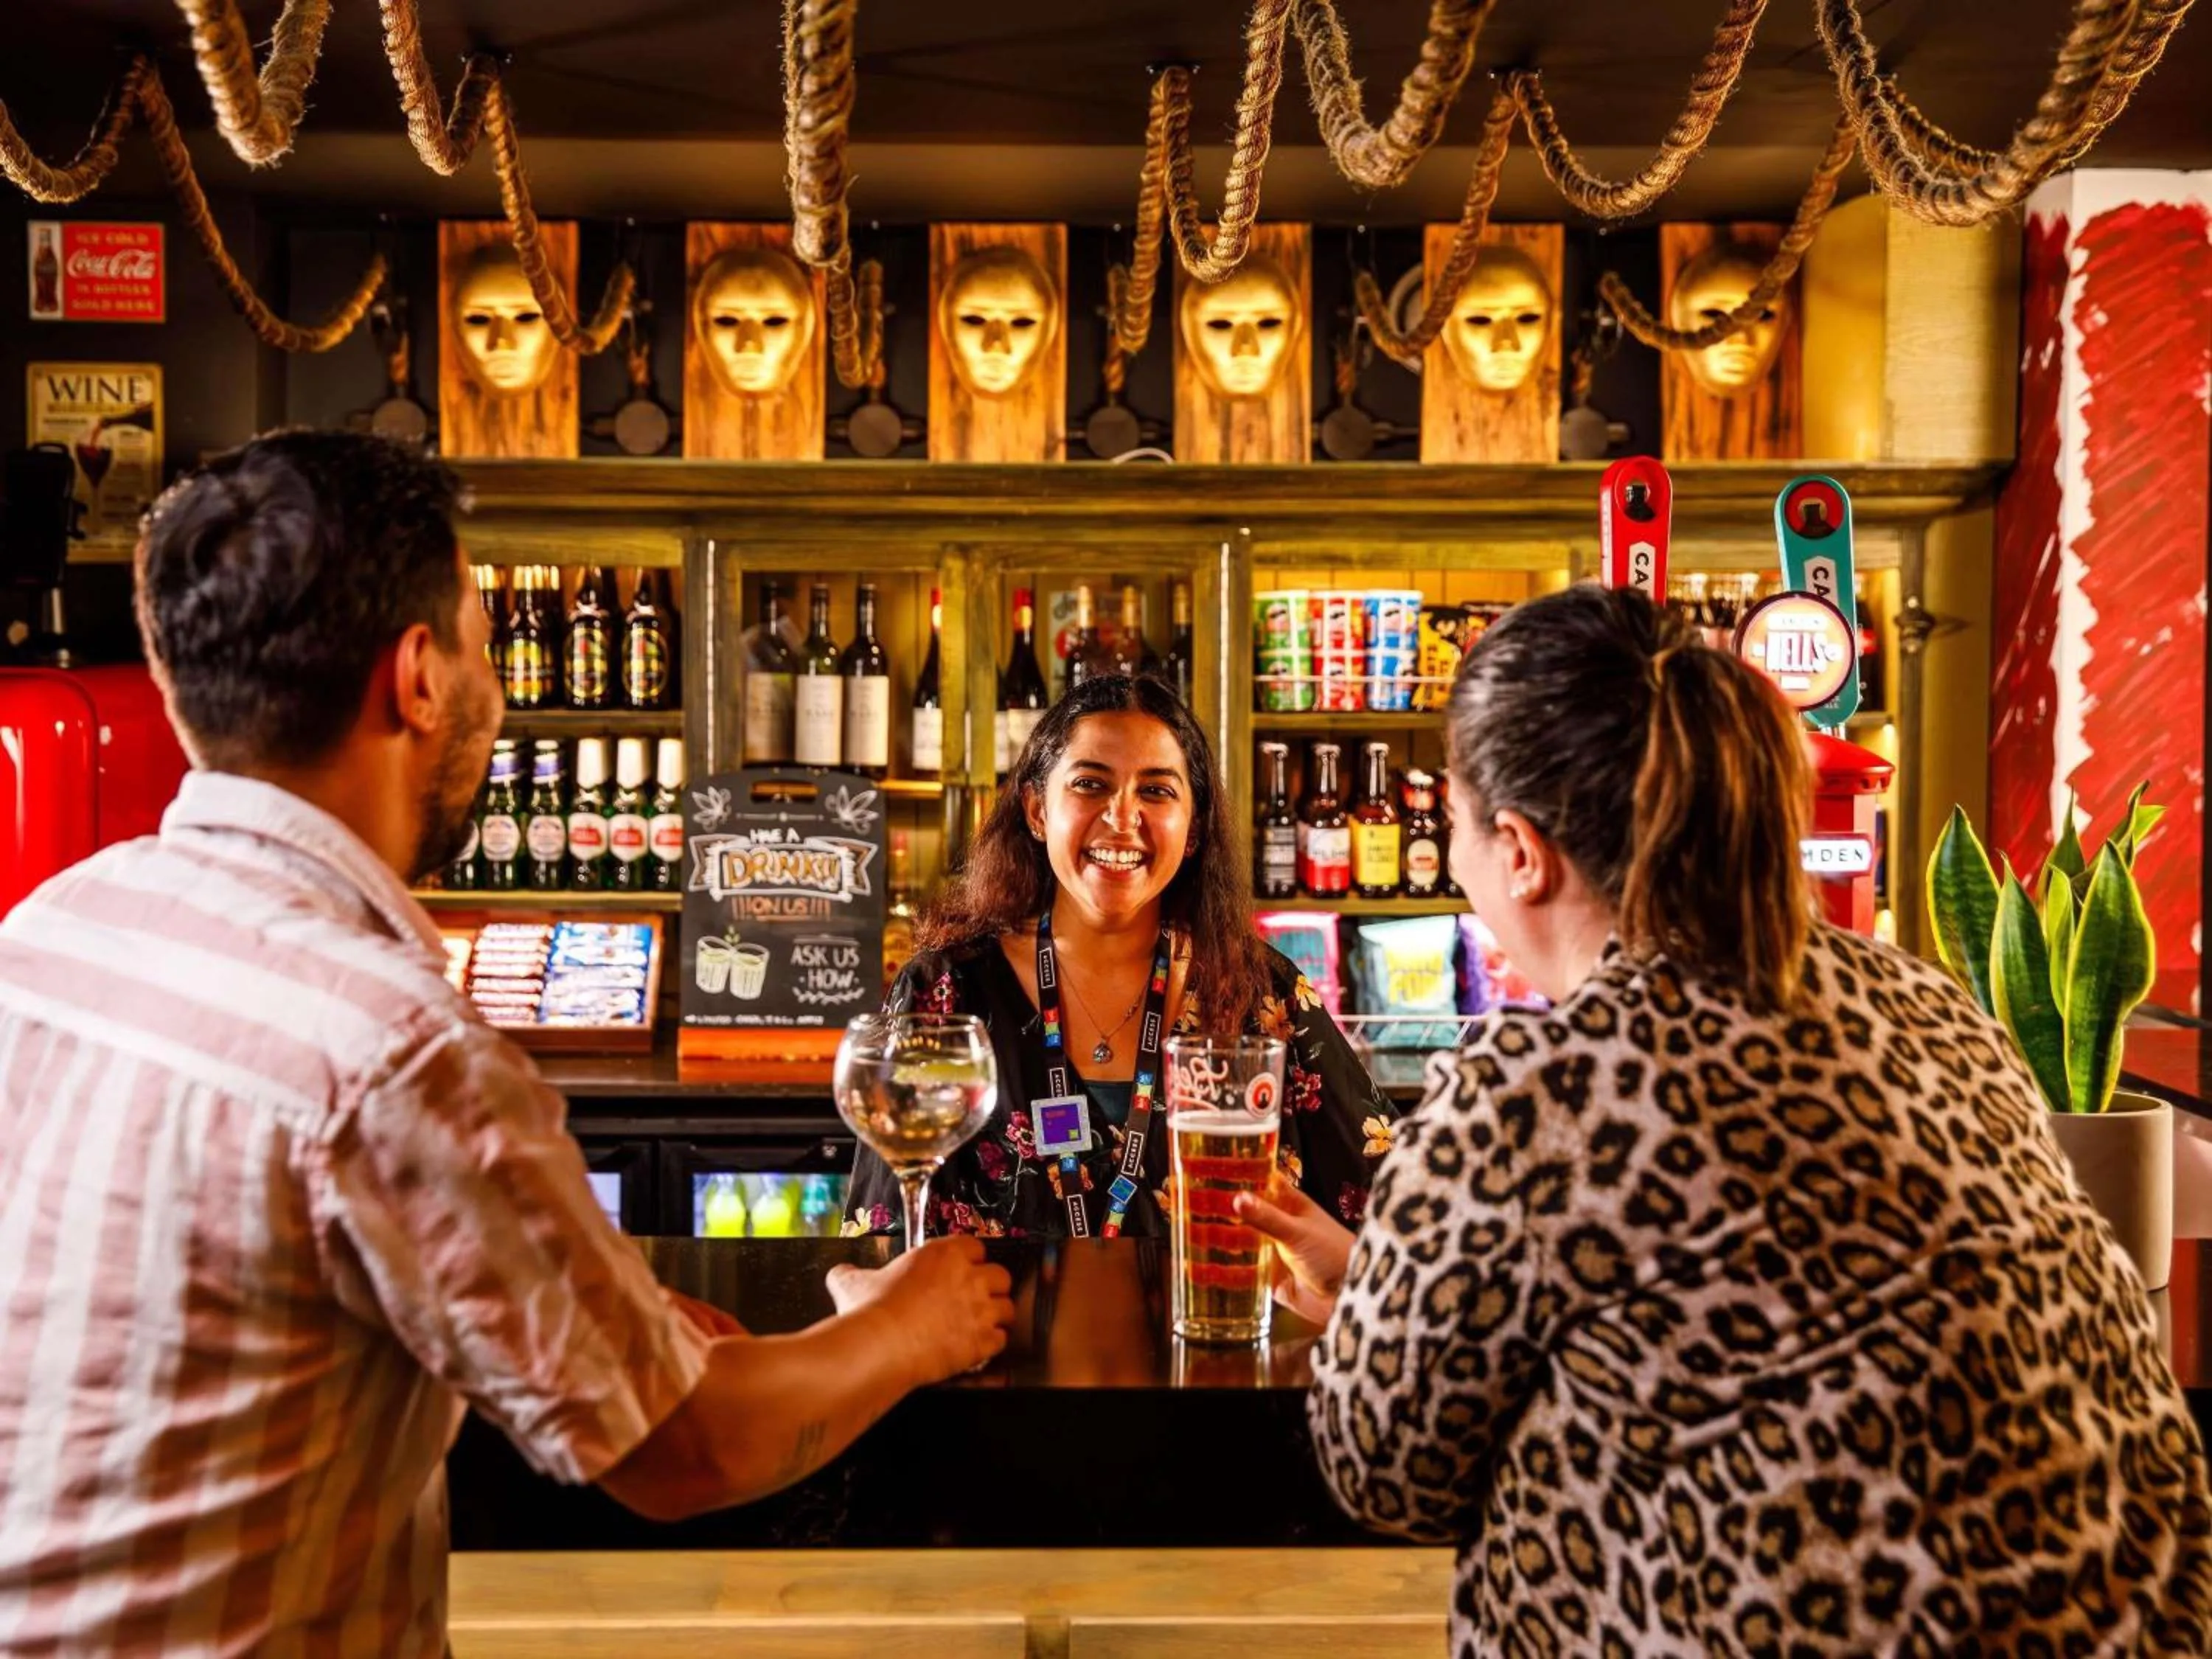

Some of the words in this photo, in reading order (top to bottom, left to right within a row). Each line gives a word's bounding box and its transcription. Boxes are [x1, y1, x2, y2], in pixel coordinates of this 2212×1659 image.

[46, 374, 142, 403] WINE
[785, 827, 801, 844] A
[790, 945, 830, 967] ASK
[832, 945, 860, 969] US
[807, 968, 854, 990] HOW
